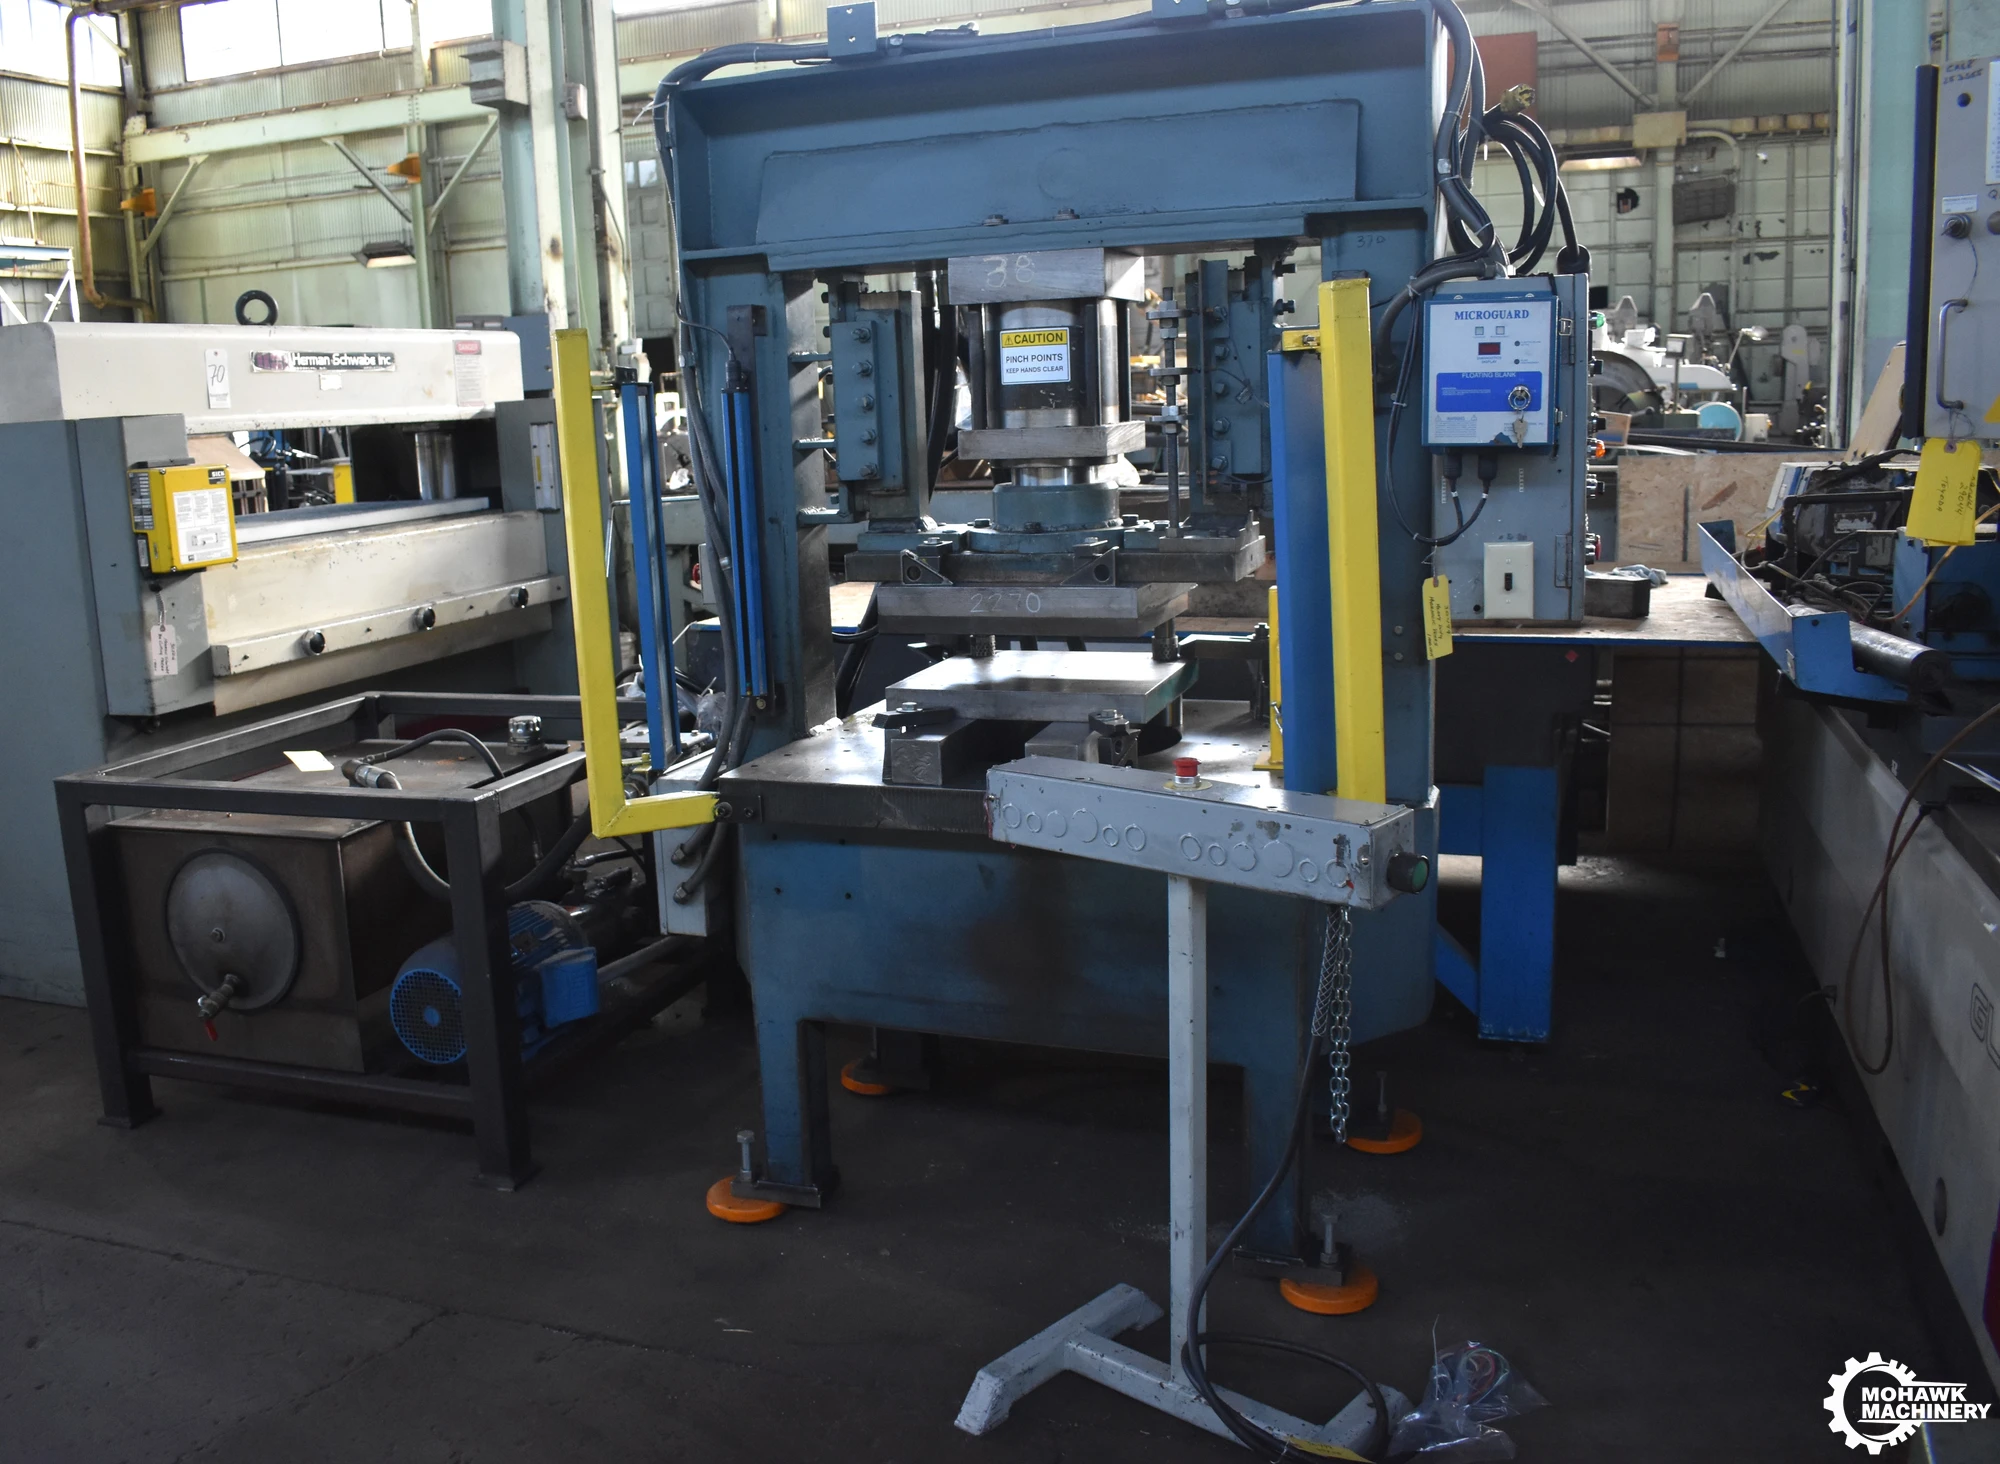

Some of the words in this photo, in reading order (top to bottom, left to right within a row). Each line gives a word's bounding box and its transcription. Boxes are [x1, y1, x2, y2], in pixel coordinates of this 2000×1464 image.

[983, 254, 1035, 288] 38
[1454, 309, 1530, 321] MICROGUARD
[1014, 332, 1064, 345] CAUTION
[292, 352, 331, 367] Herman
[1005, 355, 1029, 363] PINCH
[1031, 353, 1063, 362] POINTS
[207, 364, 226, 387] 70
[211, 470, 225, 478] SICK
[970, 591, 1041, 613] 2270
